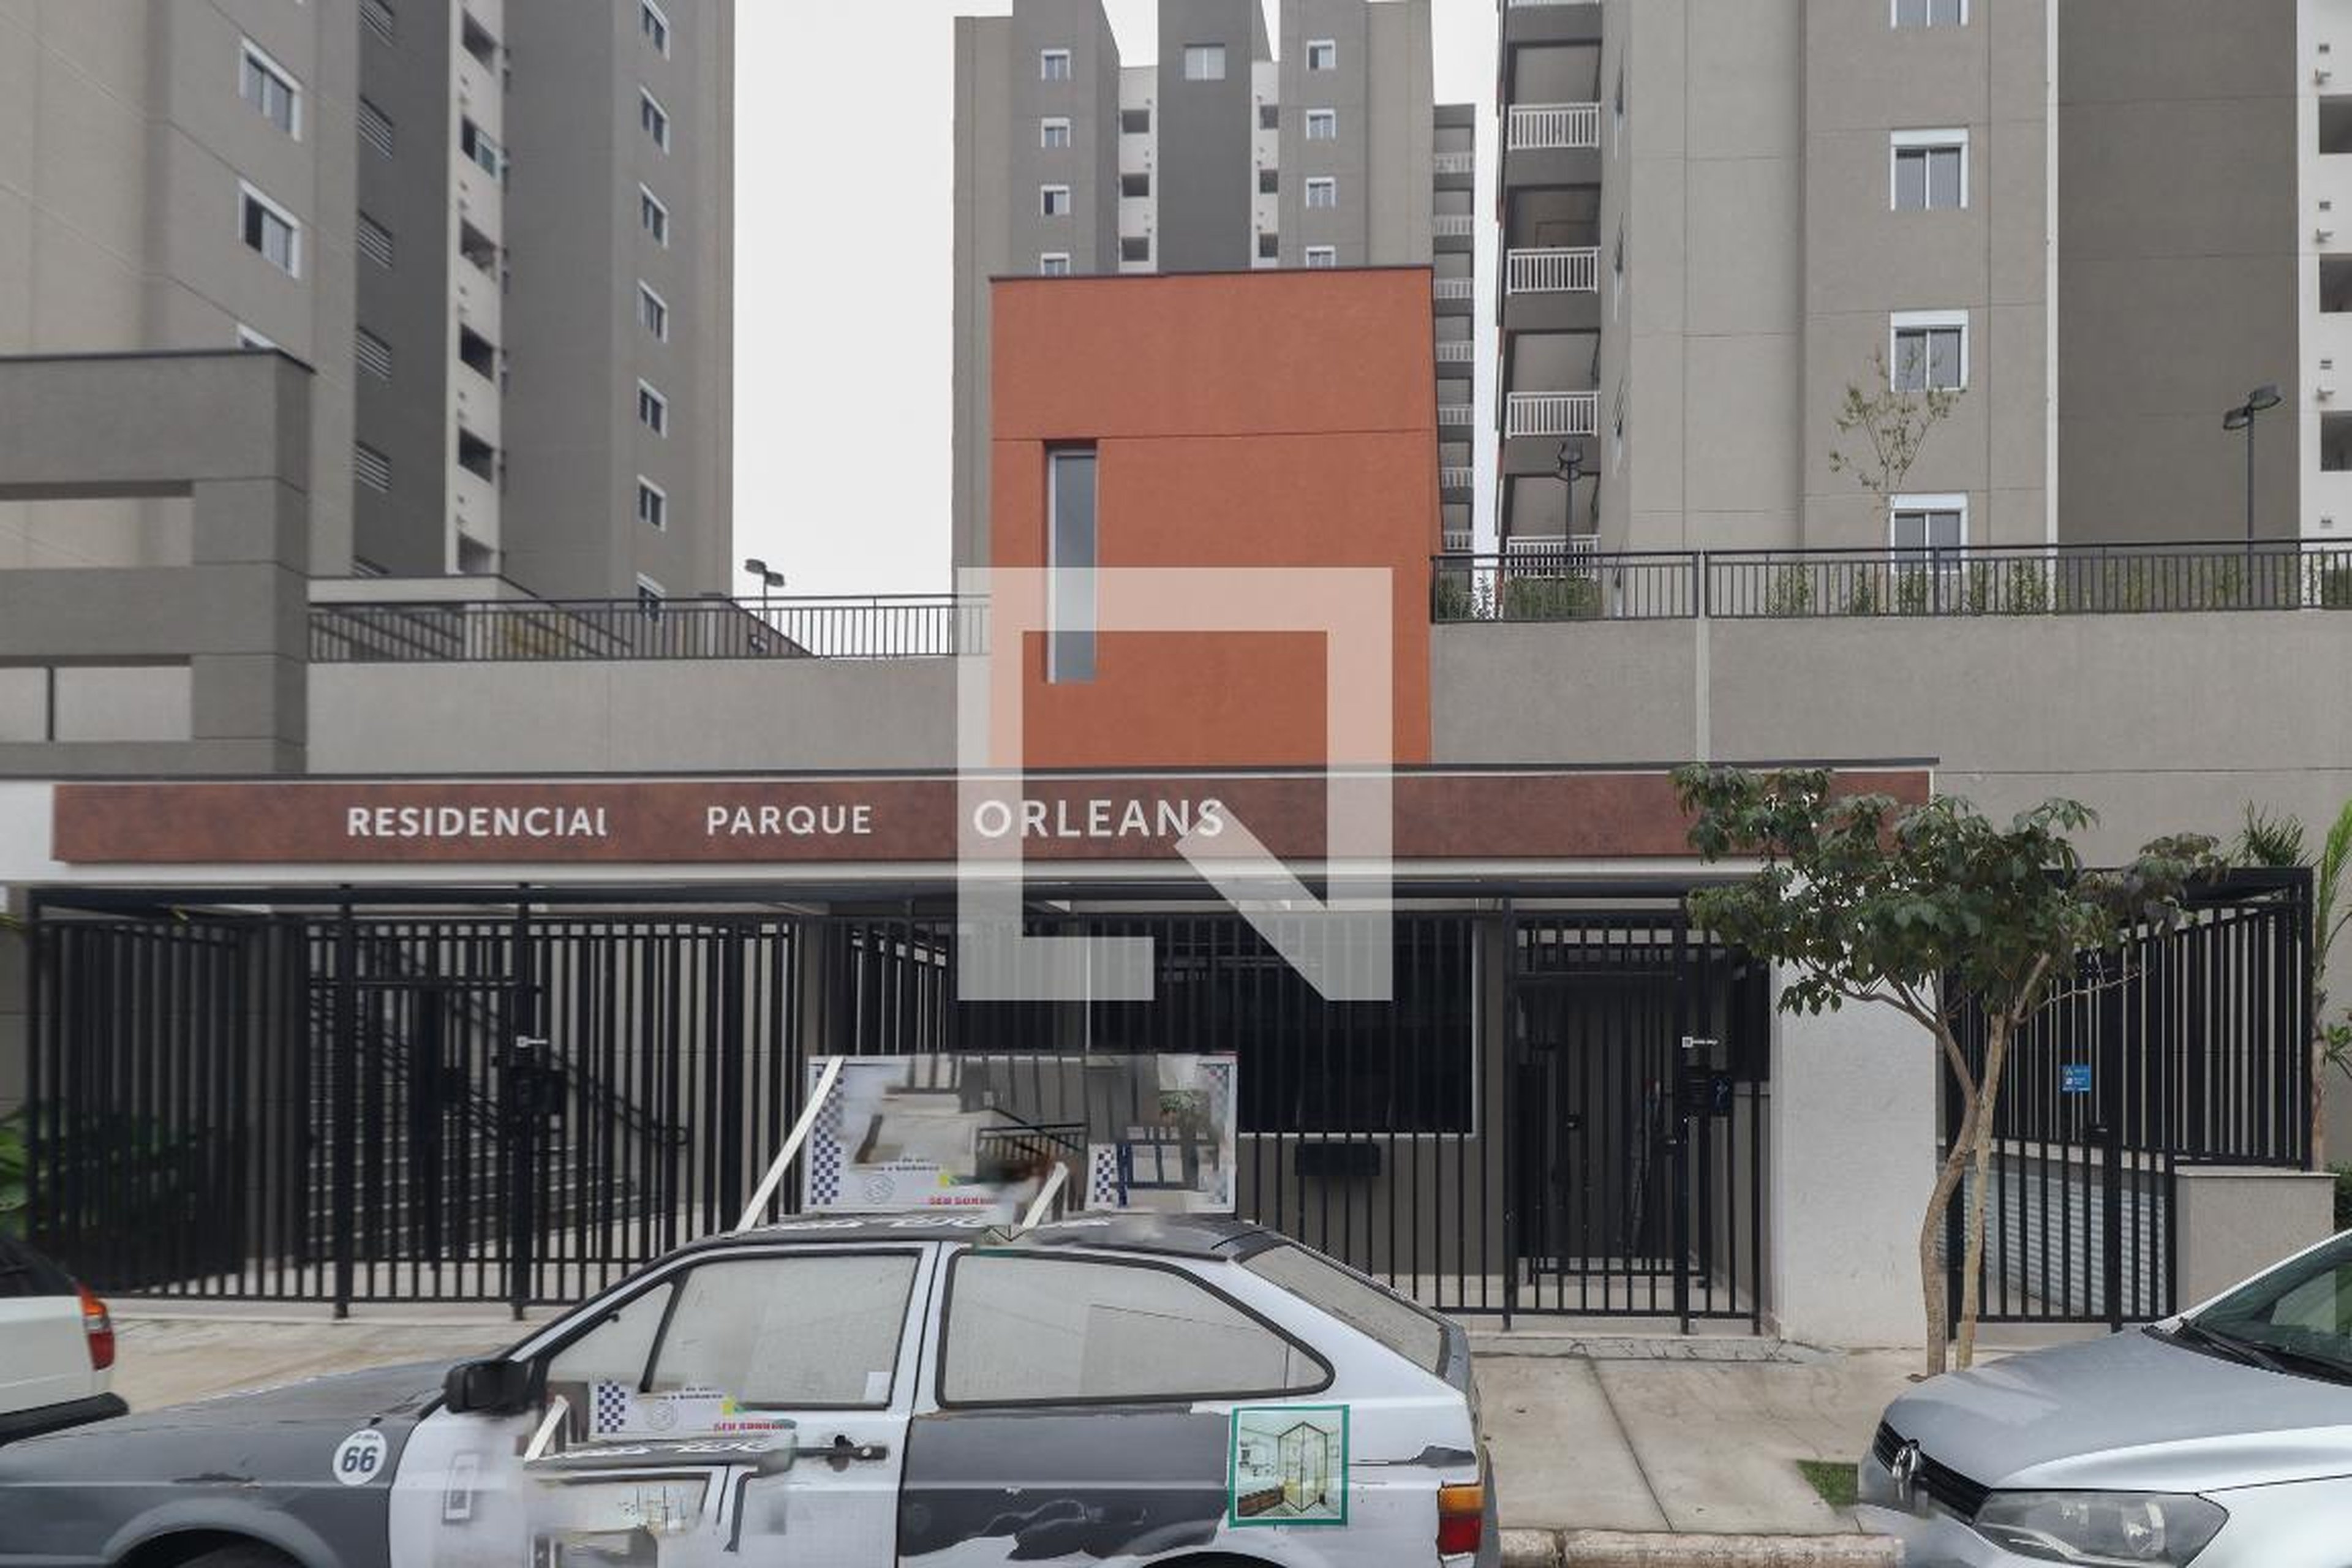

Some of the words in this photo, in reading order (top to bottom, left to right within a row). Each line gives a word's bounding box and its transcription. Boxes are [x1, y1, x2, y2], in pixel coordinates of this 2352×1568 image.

[706, 805, 872, 835] PARQUE
[973, 798, 1224, 838] ORLEANS
[342, 1446, 378, 1473] 66
